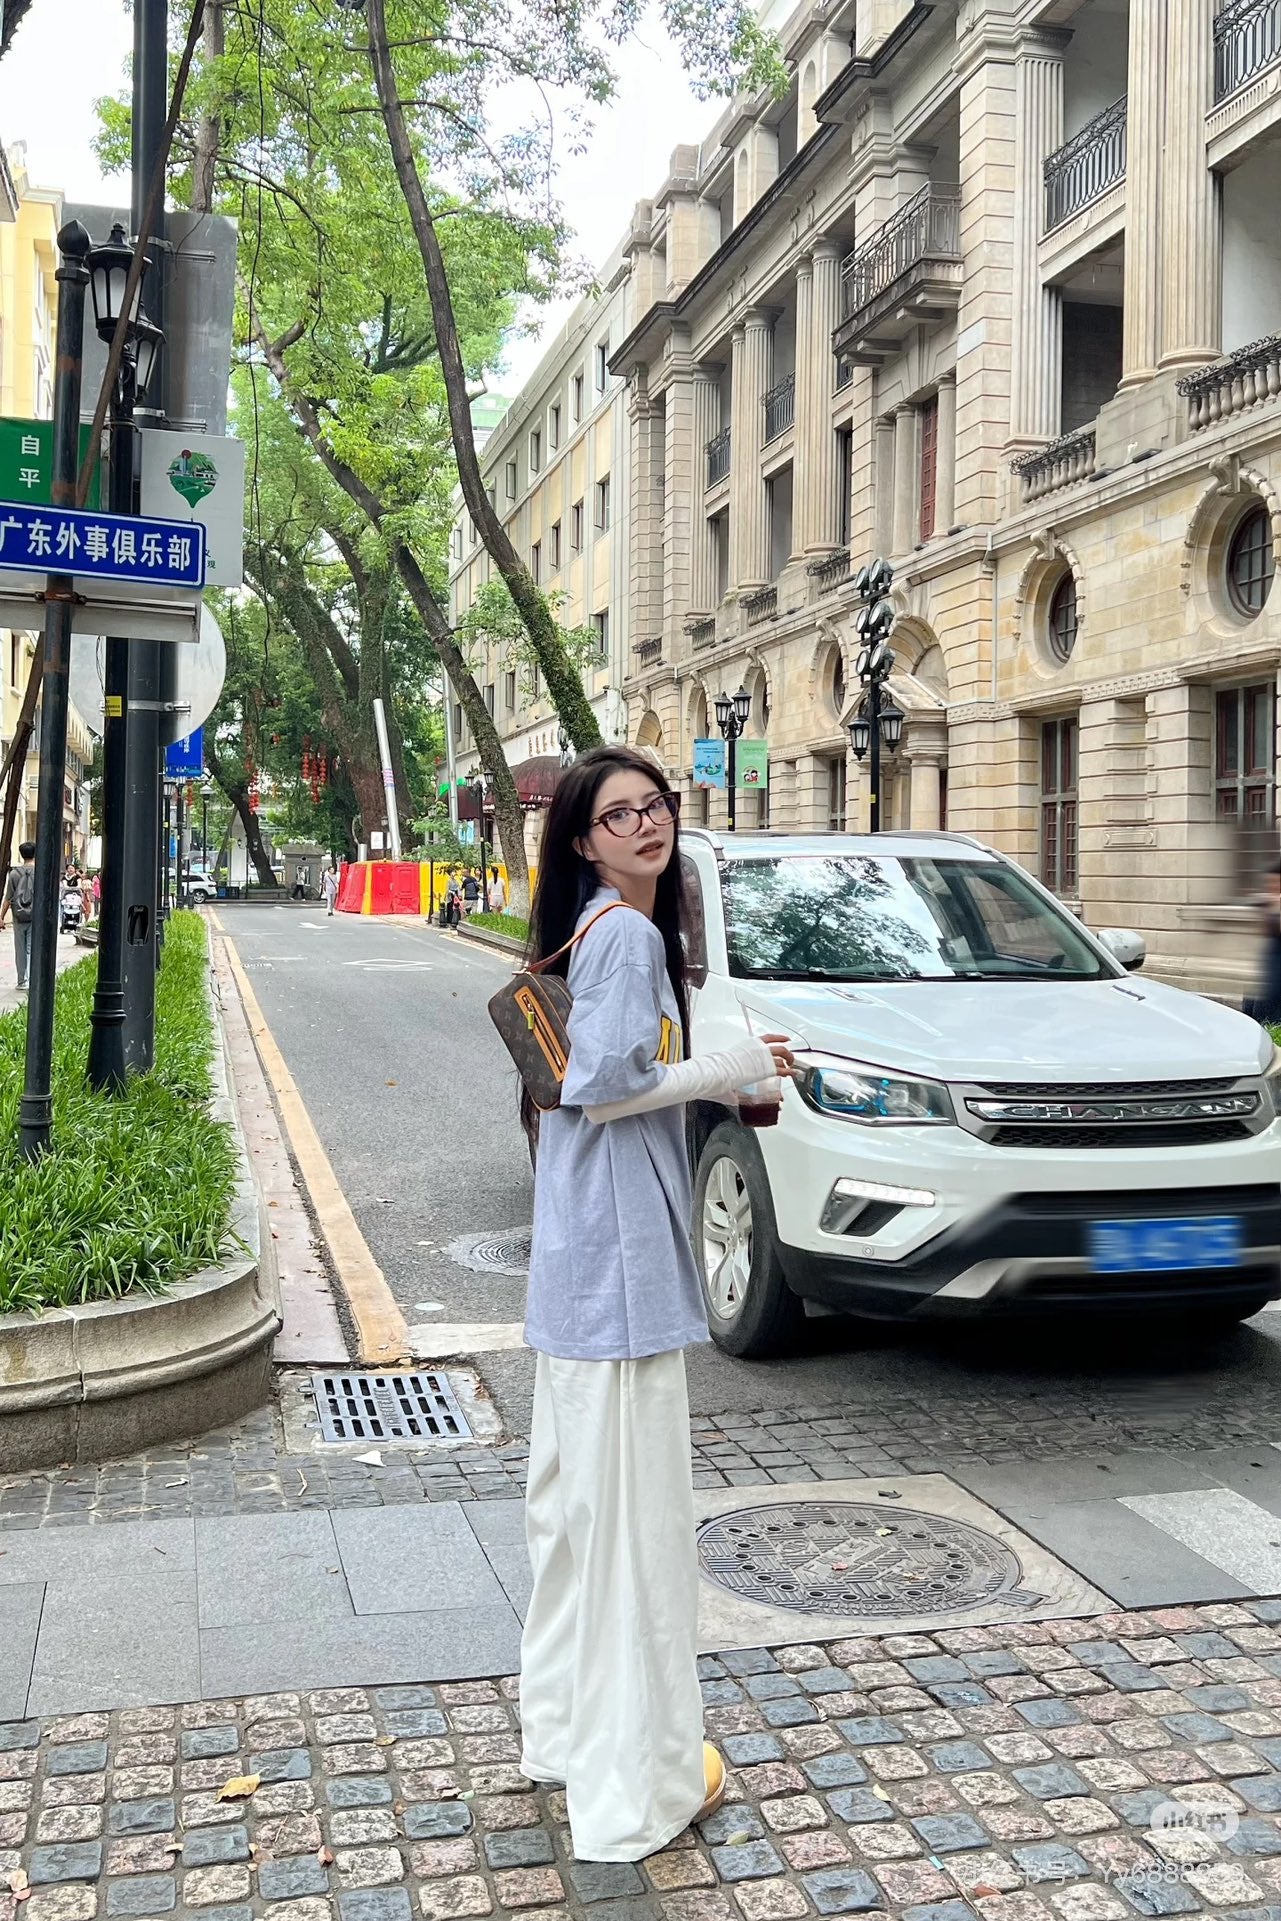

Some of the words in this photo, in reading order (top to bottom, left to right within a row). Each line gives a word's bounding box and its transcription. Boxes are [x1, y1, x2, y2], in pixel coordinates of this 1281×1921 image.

[21, 434, 40, 457] 自
[18, 467, 41, 489] 平
[0, 515, 192, 572] 广东外事俱乐部
[1001, 1094, 1256, 1121] CHANGAN
